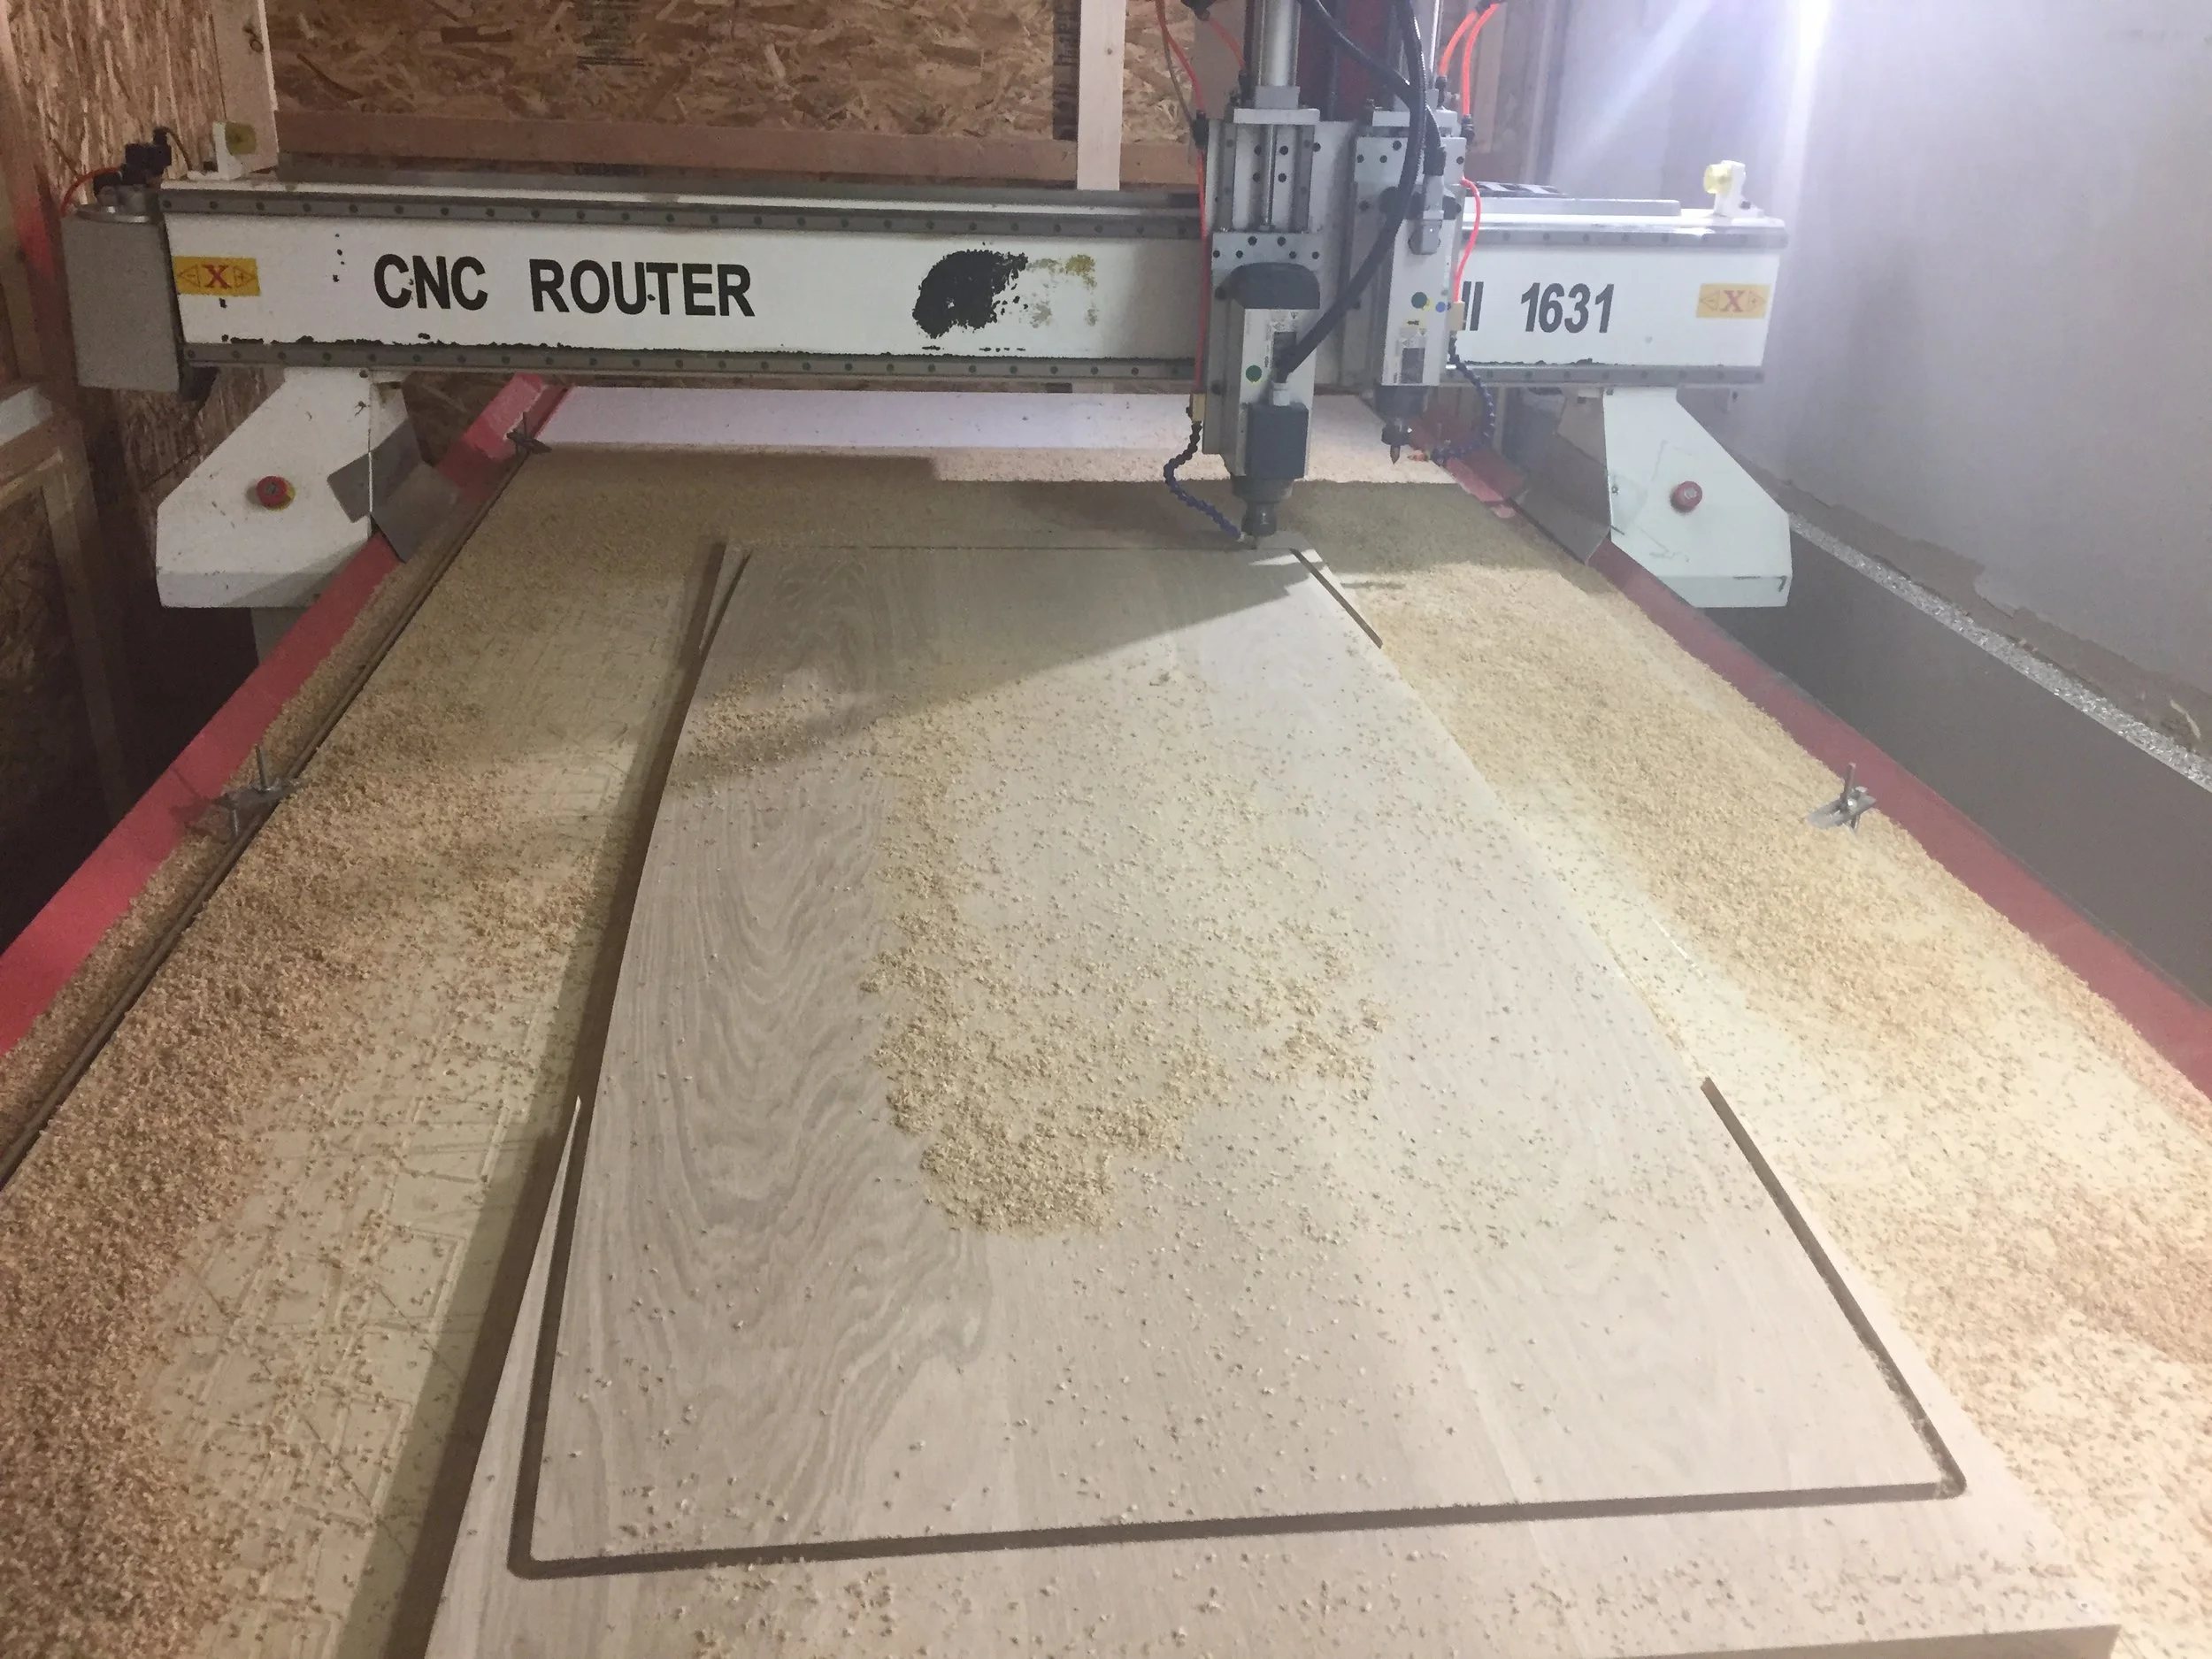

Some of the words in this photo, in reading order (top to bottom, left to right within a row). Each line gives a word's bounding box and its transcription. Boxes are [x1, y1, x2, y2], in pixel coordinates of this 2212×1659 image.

[201, 264, 232, 289] X
[374, 254, 488, 311] CNC
[529, 258, 756, 317] ROUTER
[1521, 282, 1615, 334] 1631
[1719, 289, 1746, 312] X
